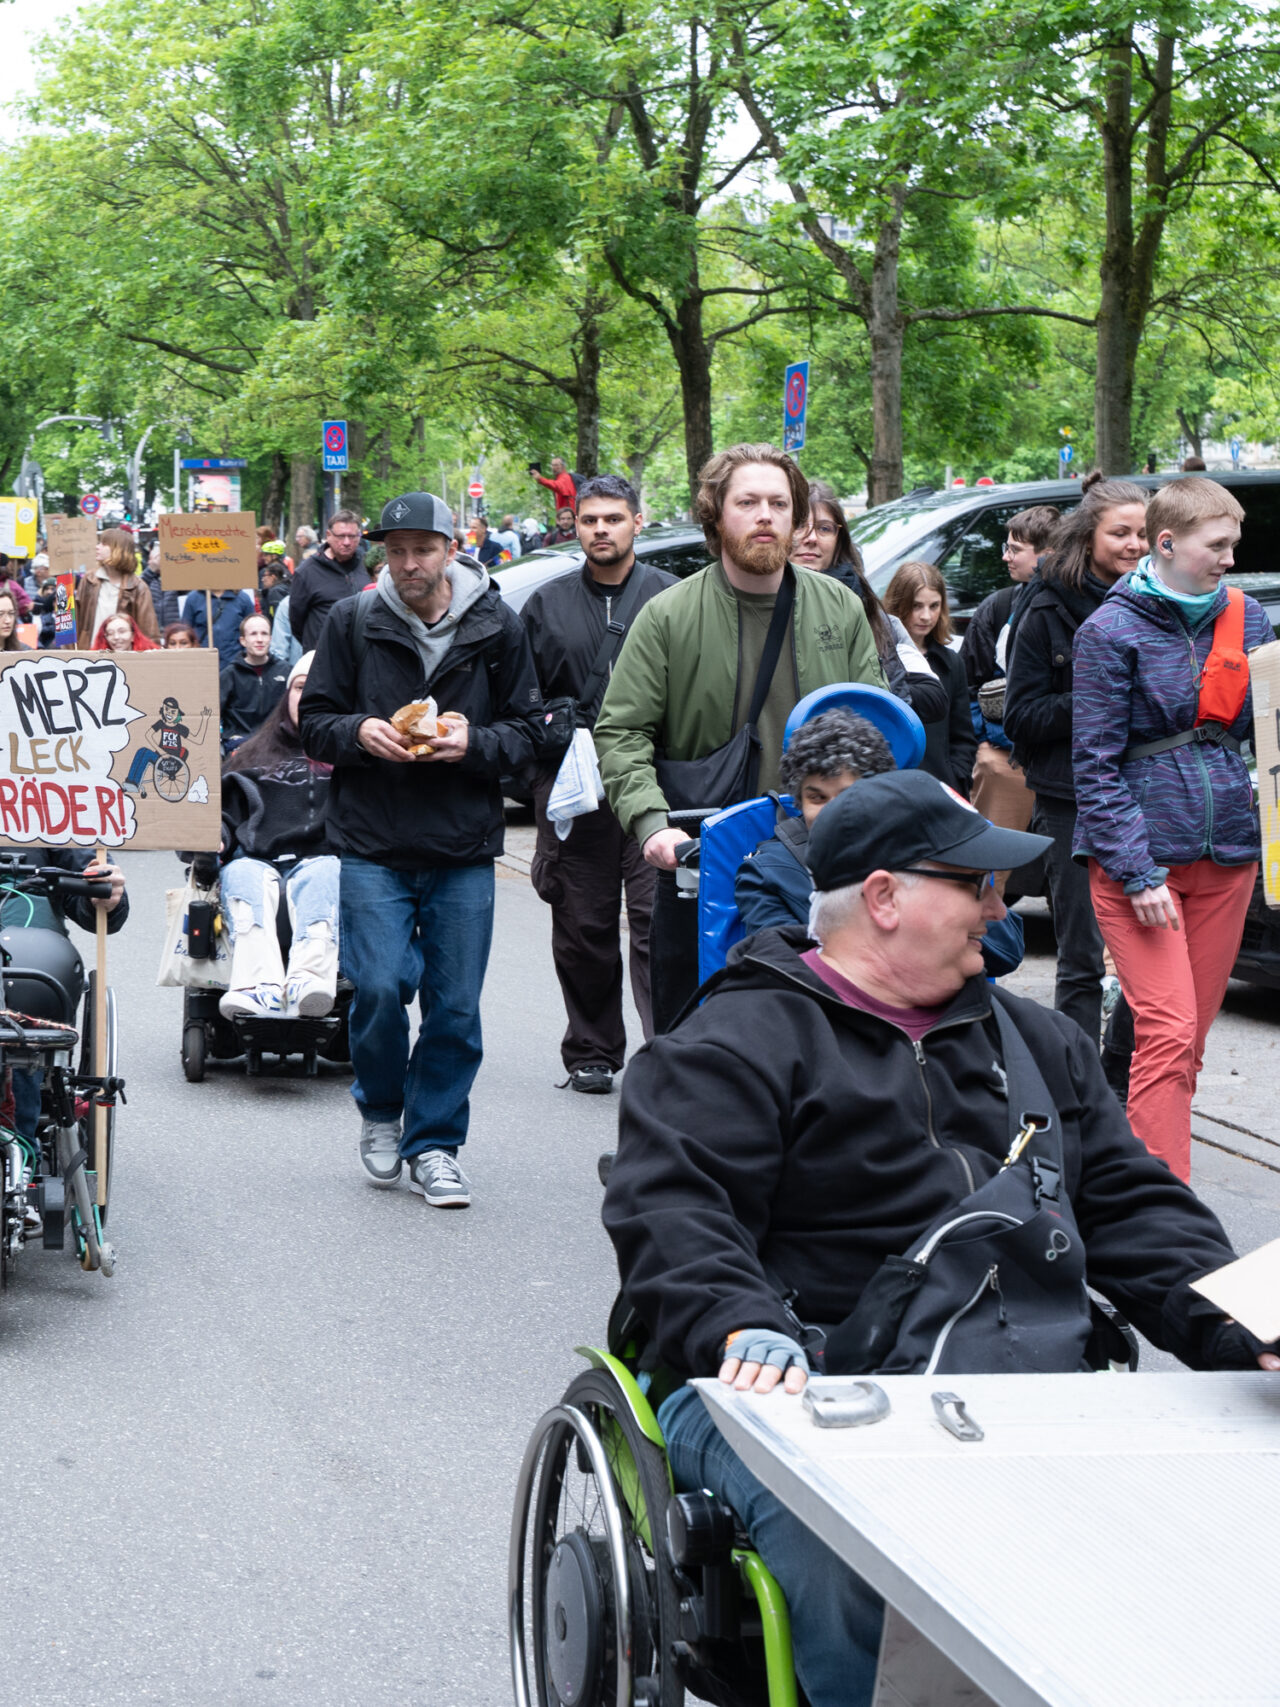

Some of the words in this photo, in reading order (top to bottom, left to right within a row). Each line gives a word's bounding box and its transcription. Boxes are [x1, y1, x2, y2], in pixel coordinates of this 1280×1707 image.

[326, 455, 346, 466] TAXI
[161, 517, 251, 539] Menschenrechte
[10, 664, 126, 737] MERZ
[163, 731, 178, 741] FCK
[9, 732, 90, 775] LECK
